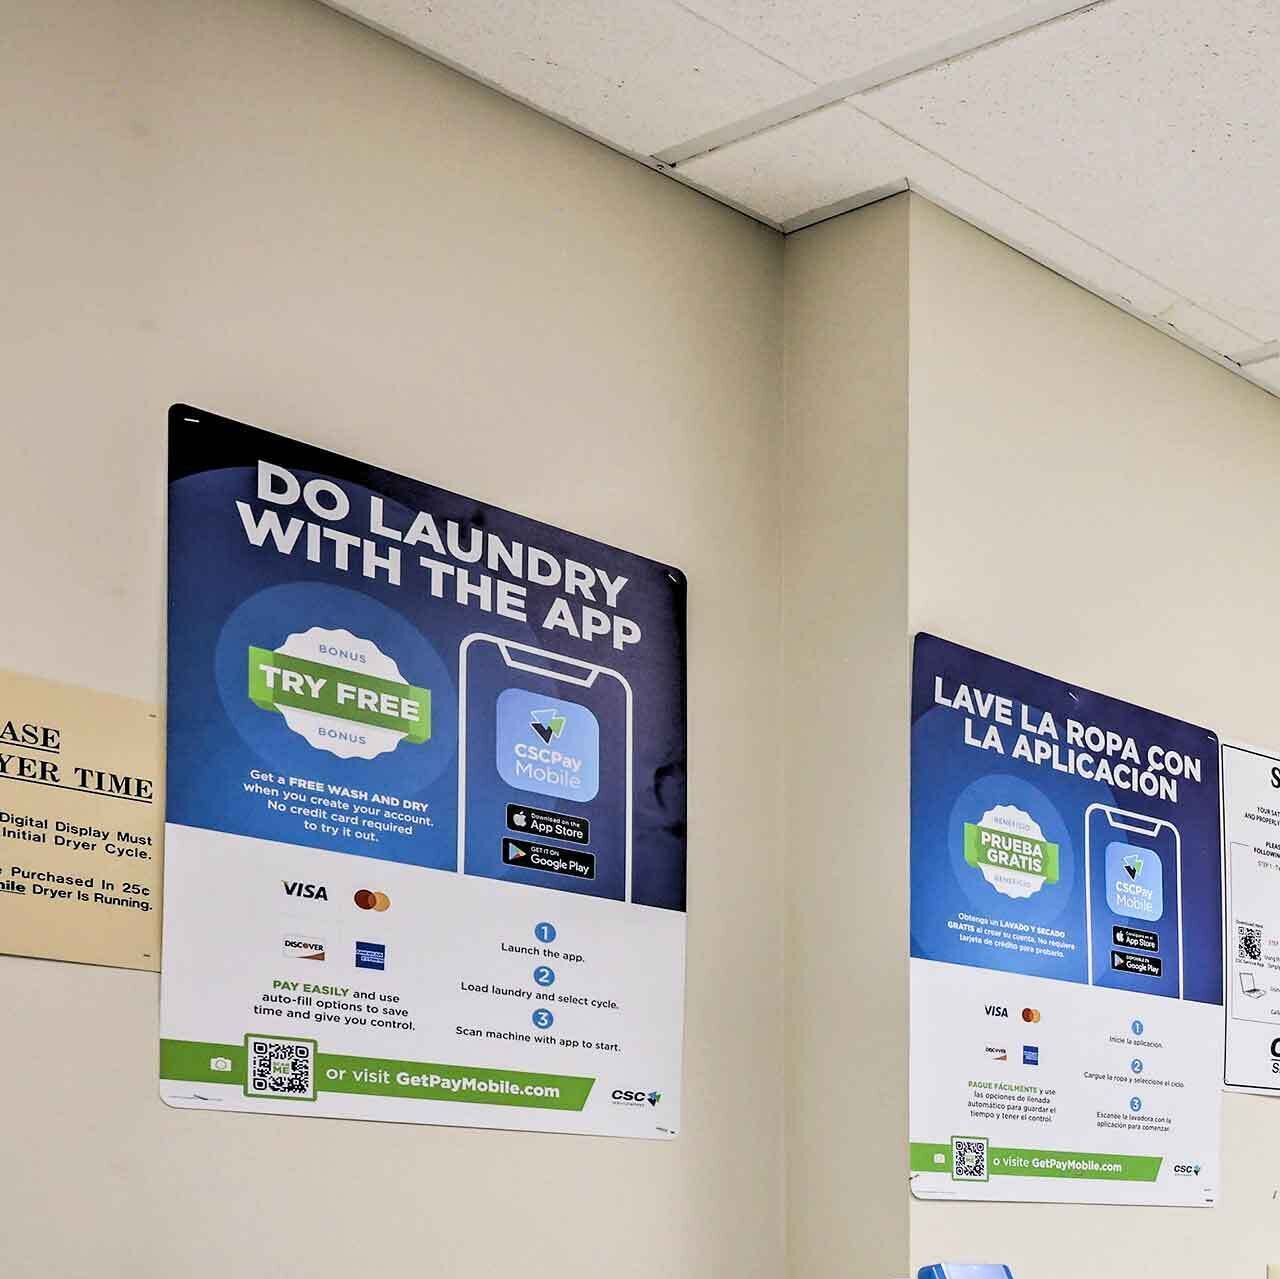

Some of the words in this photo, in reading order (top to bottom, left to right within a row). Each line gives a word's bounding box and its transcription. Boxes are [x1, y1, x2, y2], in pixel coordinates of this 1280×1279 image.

[257, 460, 349, 520] DO
[370, 496, 628, 607] LAUNDRY
[235, 500, 401, 586] WITH
[420, 557, 527, 622] THE
[542, 597, 642, 651] APP
[319, 644, 367, 664] BONUS
[260, 664, 327, 698] TRY
[337, 683, 419, 721] FREE
[0, 721, 60, 750] ASE
[318, 728, 367, 744] BONUS
[935, 676, 1012, 726] LAVE
[1021, 705, 1058, 740] LA
[1067, 719, 1140, 764] ROPA
[1148, 746, 1201, 782] CON
[514, 743, 582, 771] CSCPay
[965, 718, 1004, 754] LA
[1012, 735, 1177, 803] APLICACIÓN
[75, 767, 153, 800] TIME
[516, 760, 581, 788] Mobile
[250, 770, 273, 782] Get
[289, 777, 324, 792] FREE
[328, 785, 368, 800] WASH
[371, 793, 399, 807] AND
[403, 800, 429, 812] DRY
[244, 783, 278, 797] when
[283, 792, 306, 802] you
[311, 796, 349, 810] create
[353, 804, 380, 816] your
[384, 809, 434, 826] account.
[0, 812, 47, 830] Digital
[56, 821, 109, 841] Display
[117, 831, 152, 846] Must
[268, 800, 286, 811] No
[291, 806, 327, 819] credit
[331, 813, 358, 825] card
[362, 820, 412, 835] required
[304, 821, 316, 830] to
[321, 824, 338, 835] try
[343, 826, 351, 836] it
[355, 831, 378, 842] out.
[531, 821, 552, 833] App
[555, 827, 583, 839] Store
[2, 827, 45, 843] Initial
[55, 836, 97, 851] Dryer
[105, 844, 152, 860] Cycle.
[981, 832, 1043, 858] PRUEBA
[531, 854, 567, 870] Google
[569, 861, 589, 875] Play
[988, 850, 1042, 872] GRATIS
[12, 867, 93, 888] Purchased
[101, 880, 114, 890] In
[33, 884, 72, 901] Dryer
[77, 890, 89, 901] Is
[94, 893, 153, 912] Running.
[281, 880, 328, 901] VISA
[1116, 881, 1152, 900] CSCPay
[1117, 894, 1152, 912] Mobile
[285, 940, 323, 951] DISCOVER
[502, 943, 539, 956] Launch
[544, 949, 559, 959] the
[563, 953, 585, 963] app.
[1126, 937, 1138, 946] App
[1140, 939, 1155, 948] Store
[1126, 961, 1146, 971] Google
[1147, 965, 1159, 974] Play
[273, 980, 299, 991] PAY
[304, 983, 349, 997] EASILY
[353, 991, 375, 1000] and
[380, 994, 400, 1002] use
[462, 982, 488, 992] Load
[492, 985, 532, 999] laundry
[536, 991, 554, 1001] and
[558, 995, 588, 1005] select
[591, 999, 620, 1009] cycle.
[262, 994, 312, 1006] auto-fill
[316, 999, 362, 1012] options
[367, 1004, 378, 1013] to
[383, 1006, 408, 1016] save
[985, 1006, 1008, 1018] VISA
[254, 1005, 282, 1016] time
[287, 1009, 310, 1020] and
[315, 1011, 340, 1023] give
[345, 1016, 366, 1025] you
[371, 1018, 415, 1031] control.
[456, 1027, 482, 1037] Scan
[486, 1030, 531, 1042] machine
[534, 1035, 556, 1044] with
[560, 1039, 578, 1048] app
[582, 1040, 592, 1048] to
[596, 1042, 621, 1052] start.
[273, 1065, 289, 1074] ME
[326, 1067, 346, 1081] or
[353, 1069, 390, 1083] visit
[396, 1072, 560, 1098] GetPayMobile.com
[612, 1090, 646, 1101] CSC
[1003, 1156, 1029, 1168] visite
[1032, 1159, 1122, 1173] GetPayMobile.com
[1174, 1164, 1192, 1173] CSC
